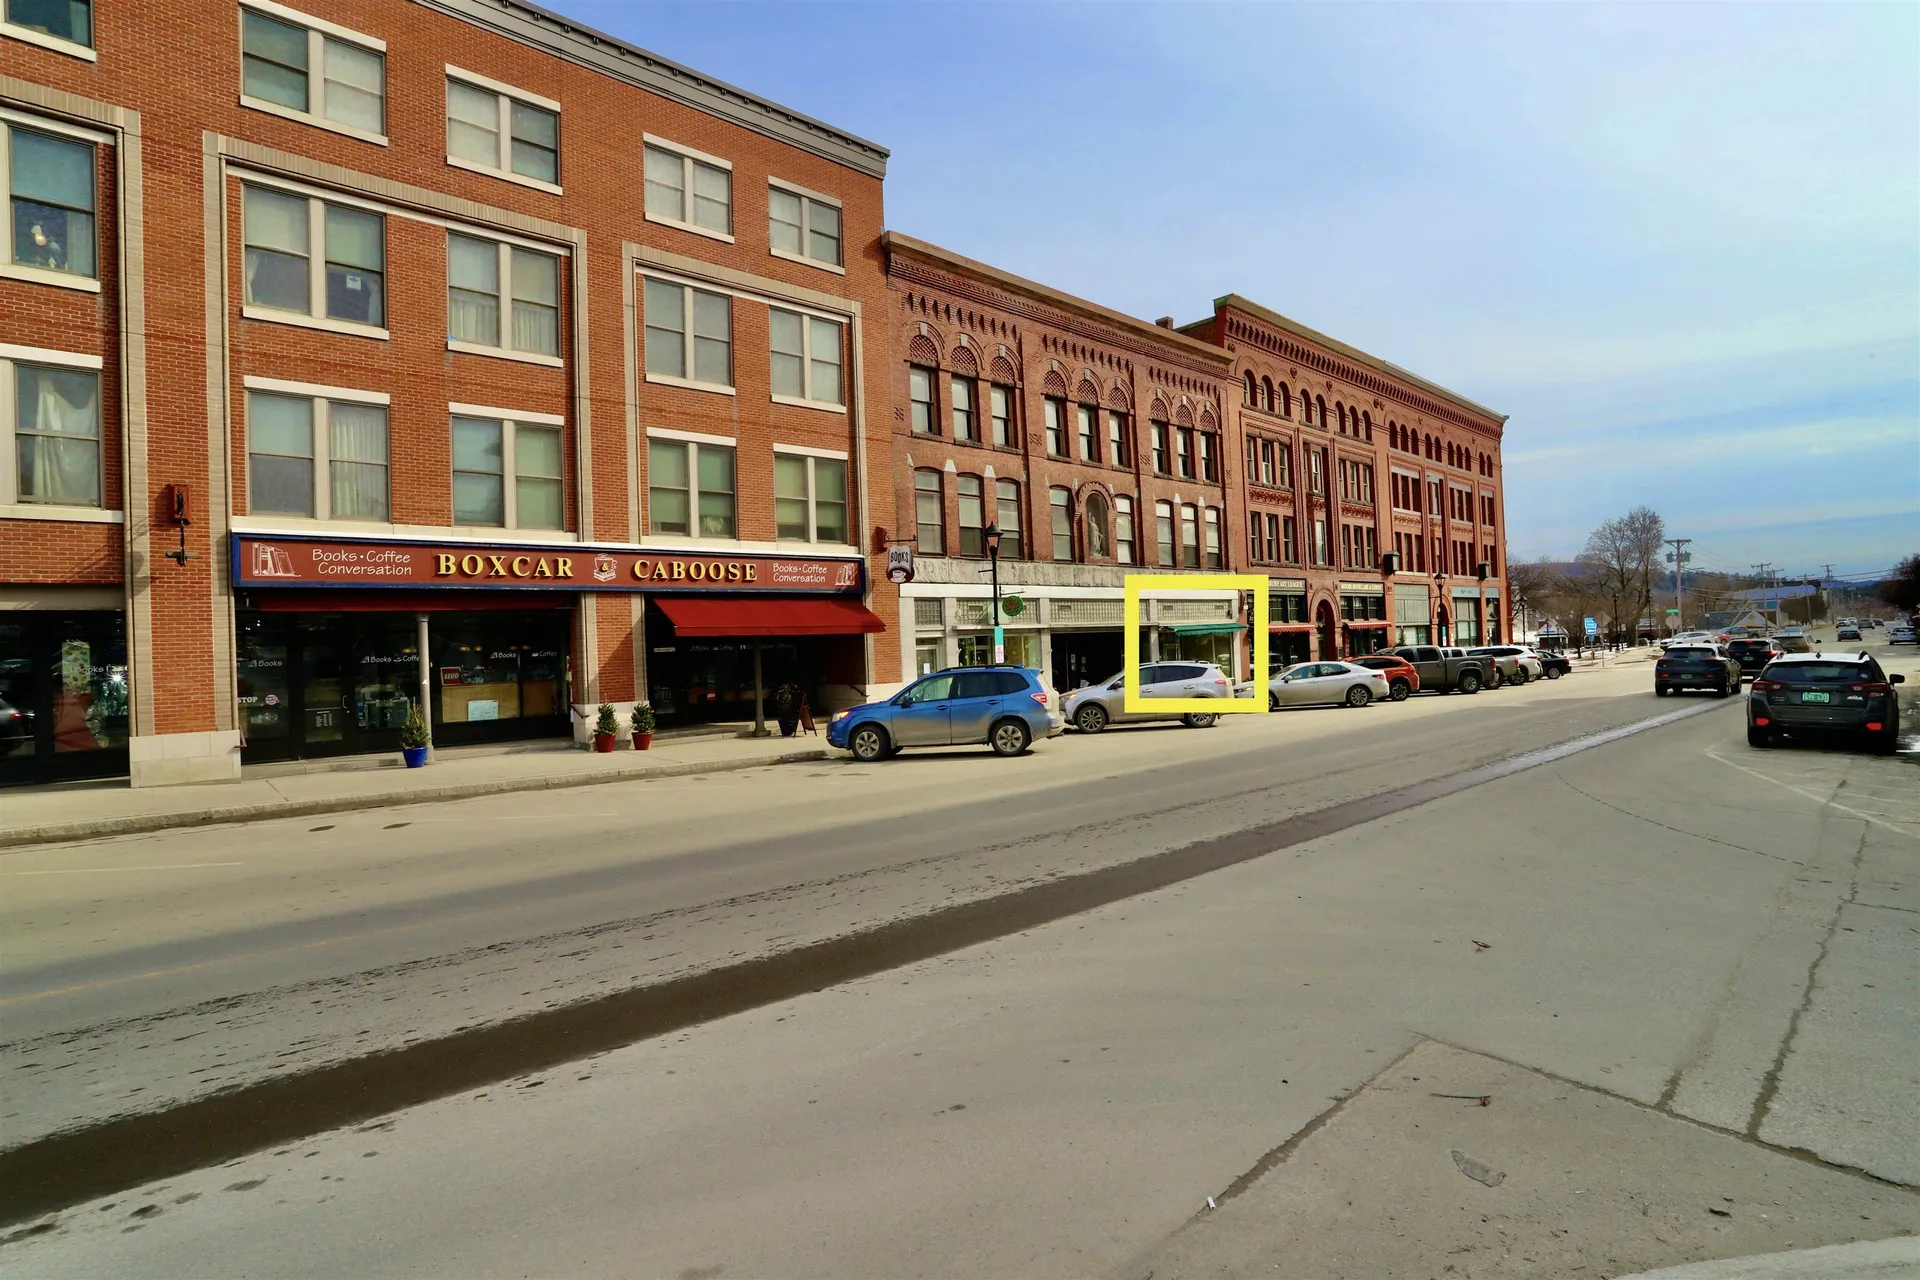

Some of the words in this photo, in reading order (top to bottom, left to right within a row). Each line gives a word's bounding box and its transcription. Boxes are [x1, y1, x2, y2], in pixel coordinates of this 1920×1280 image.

[312, 548, 358, 562] Books
[366, 550, 411, 563] Coffee
[890, 551, 909, 564] BOOKS
[318, 562, 412, 576] Conversation
[437, 553, 574, 578] BOXCAR
[602, 562, 610, 571] &
[634, 559, 758, 581] CABOOSE
[773, 562, 798, 573] Books
[802, 563, 827, 574] Coffee
[773, 572, 826, 583] Conversation
[370, 655, 392, 663] Books
[402, 655, 420, 663] Coffe
[498, 651, 517, 659] Books
[539, 650, 558, 658] Coffee
[444, 672, 460, 680] LEGO
